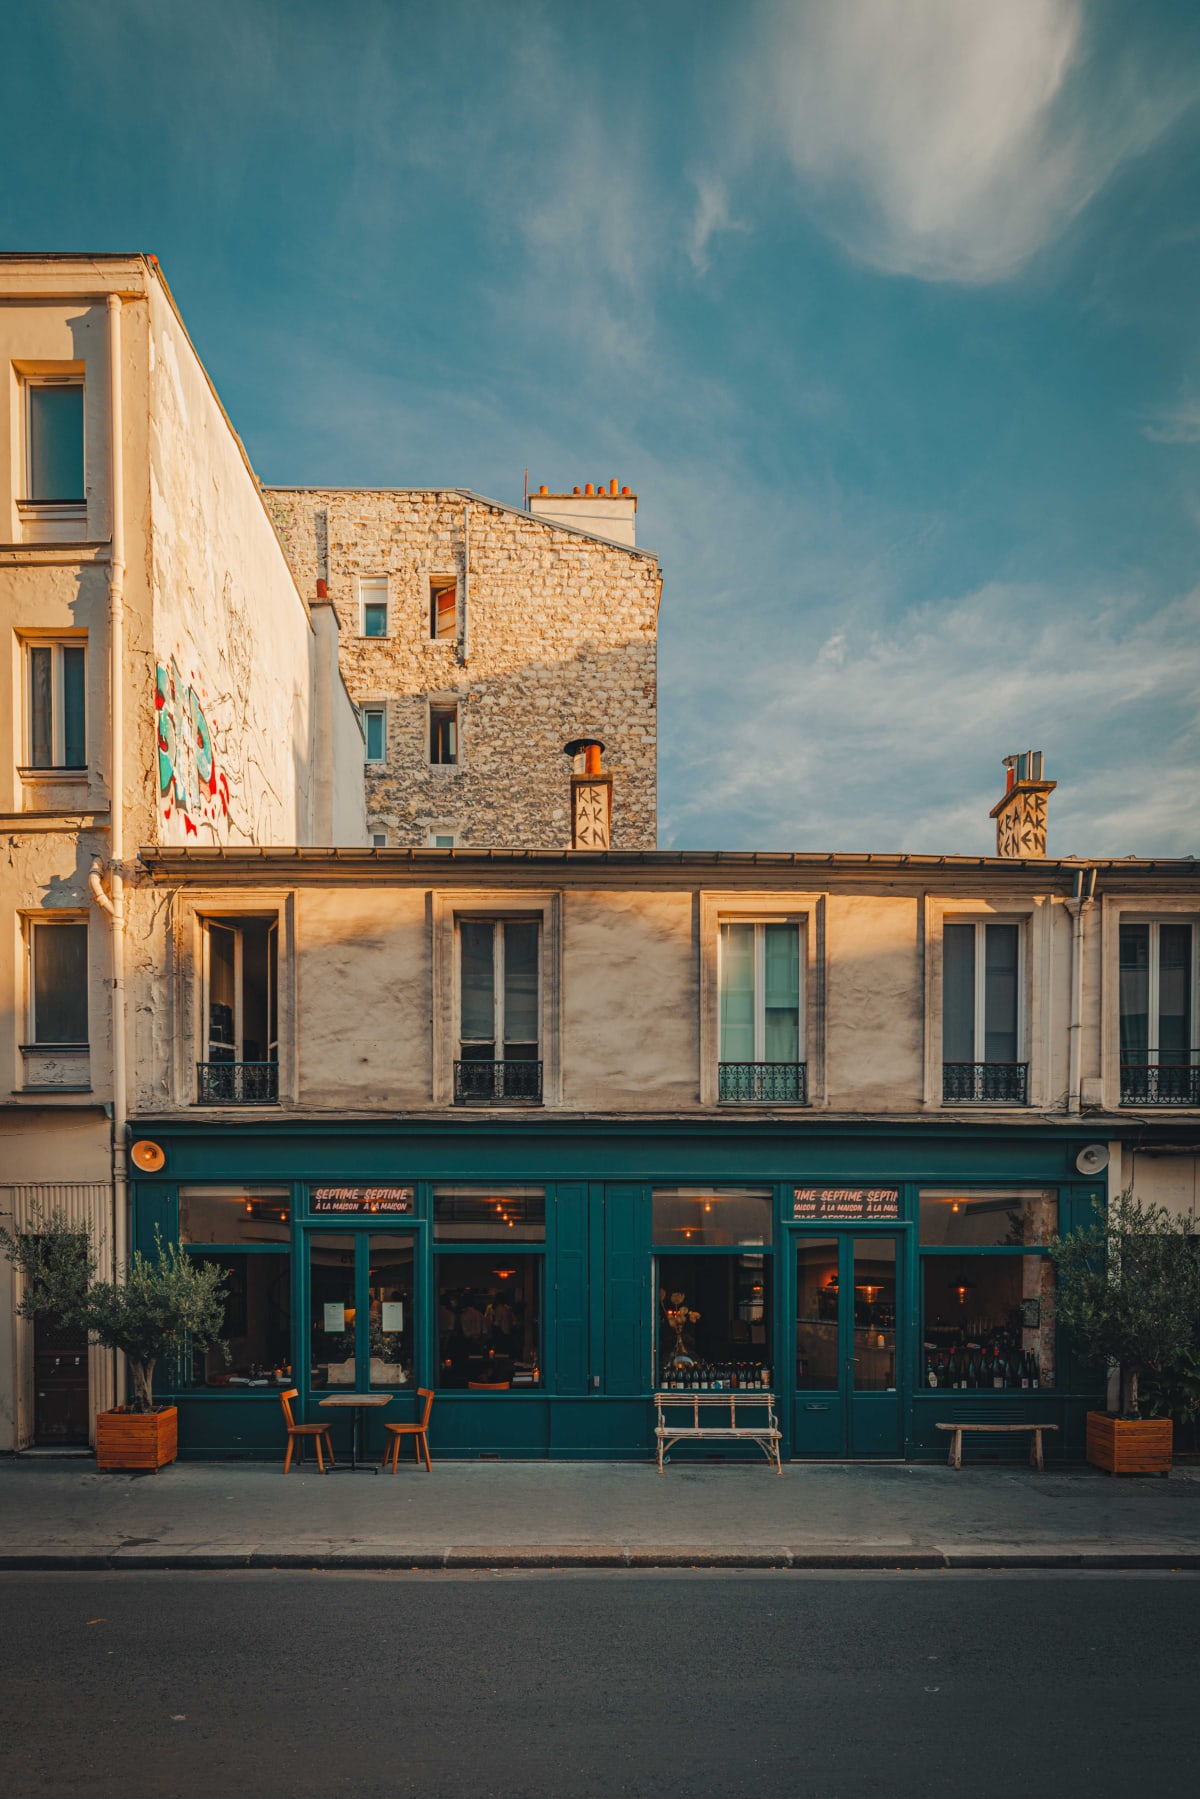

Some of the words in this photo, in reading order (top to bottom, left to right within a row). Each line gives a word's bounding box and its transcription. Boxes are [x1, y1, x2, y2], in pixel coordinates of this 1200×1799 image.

[315, 1188, 359, 1200] SEPTIME
[364, 1188, 408, 1200] SEPTIME
[820, 1190, 863, 1202] SEPTIME
